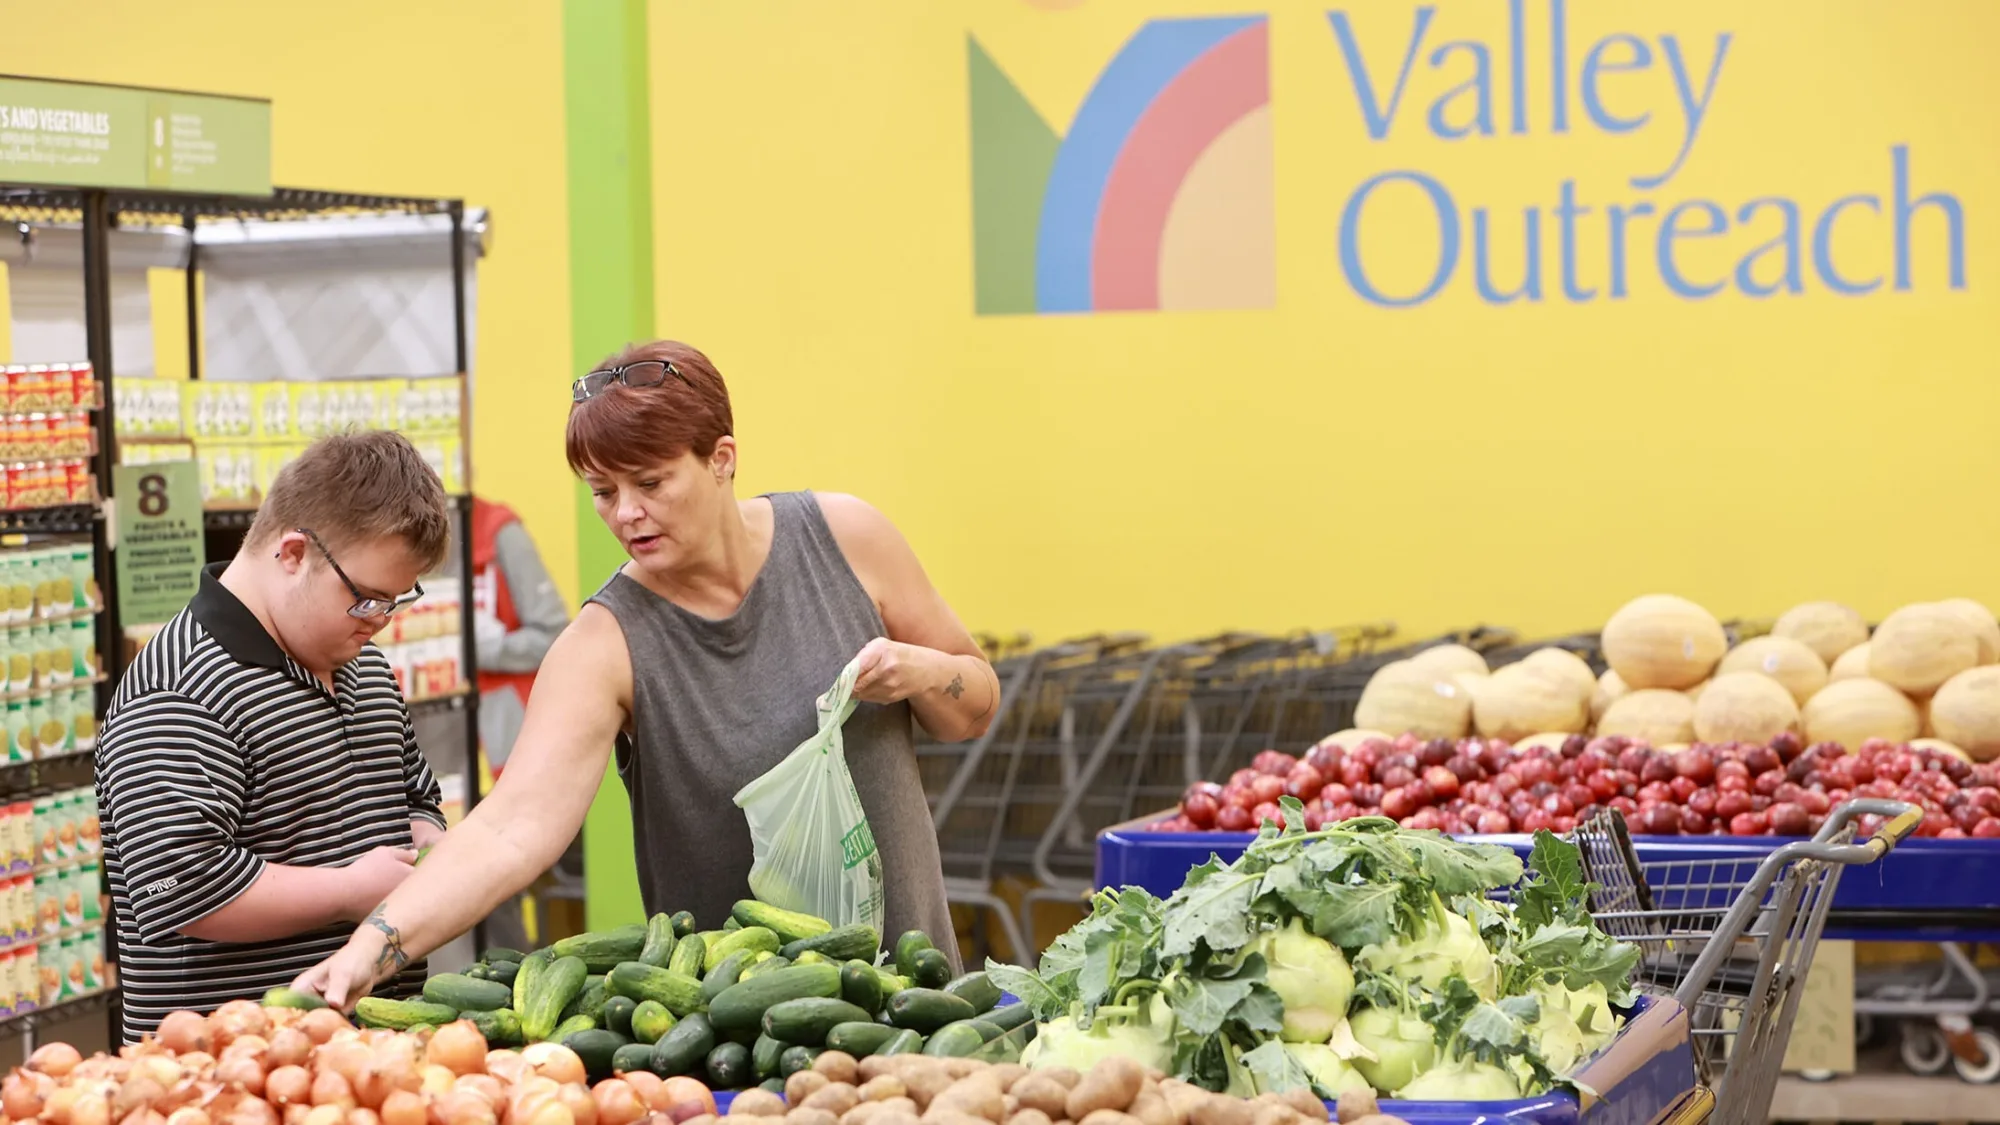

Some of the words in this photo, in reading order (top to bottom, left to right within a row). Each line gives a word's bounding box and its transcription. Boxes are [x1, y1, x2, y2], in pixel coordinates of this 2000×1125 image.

[1324, 0, 1734, 188] Valley
[10, 105, 38, 131] AND
[1337, 143, 1967, 308] Outreach
[138, 473, 169, 517] 8
[146, 877, 178, 896] PING
